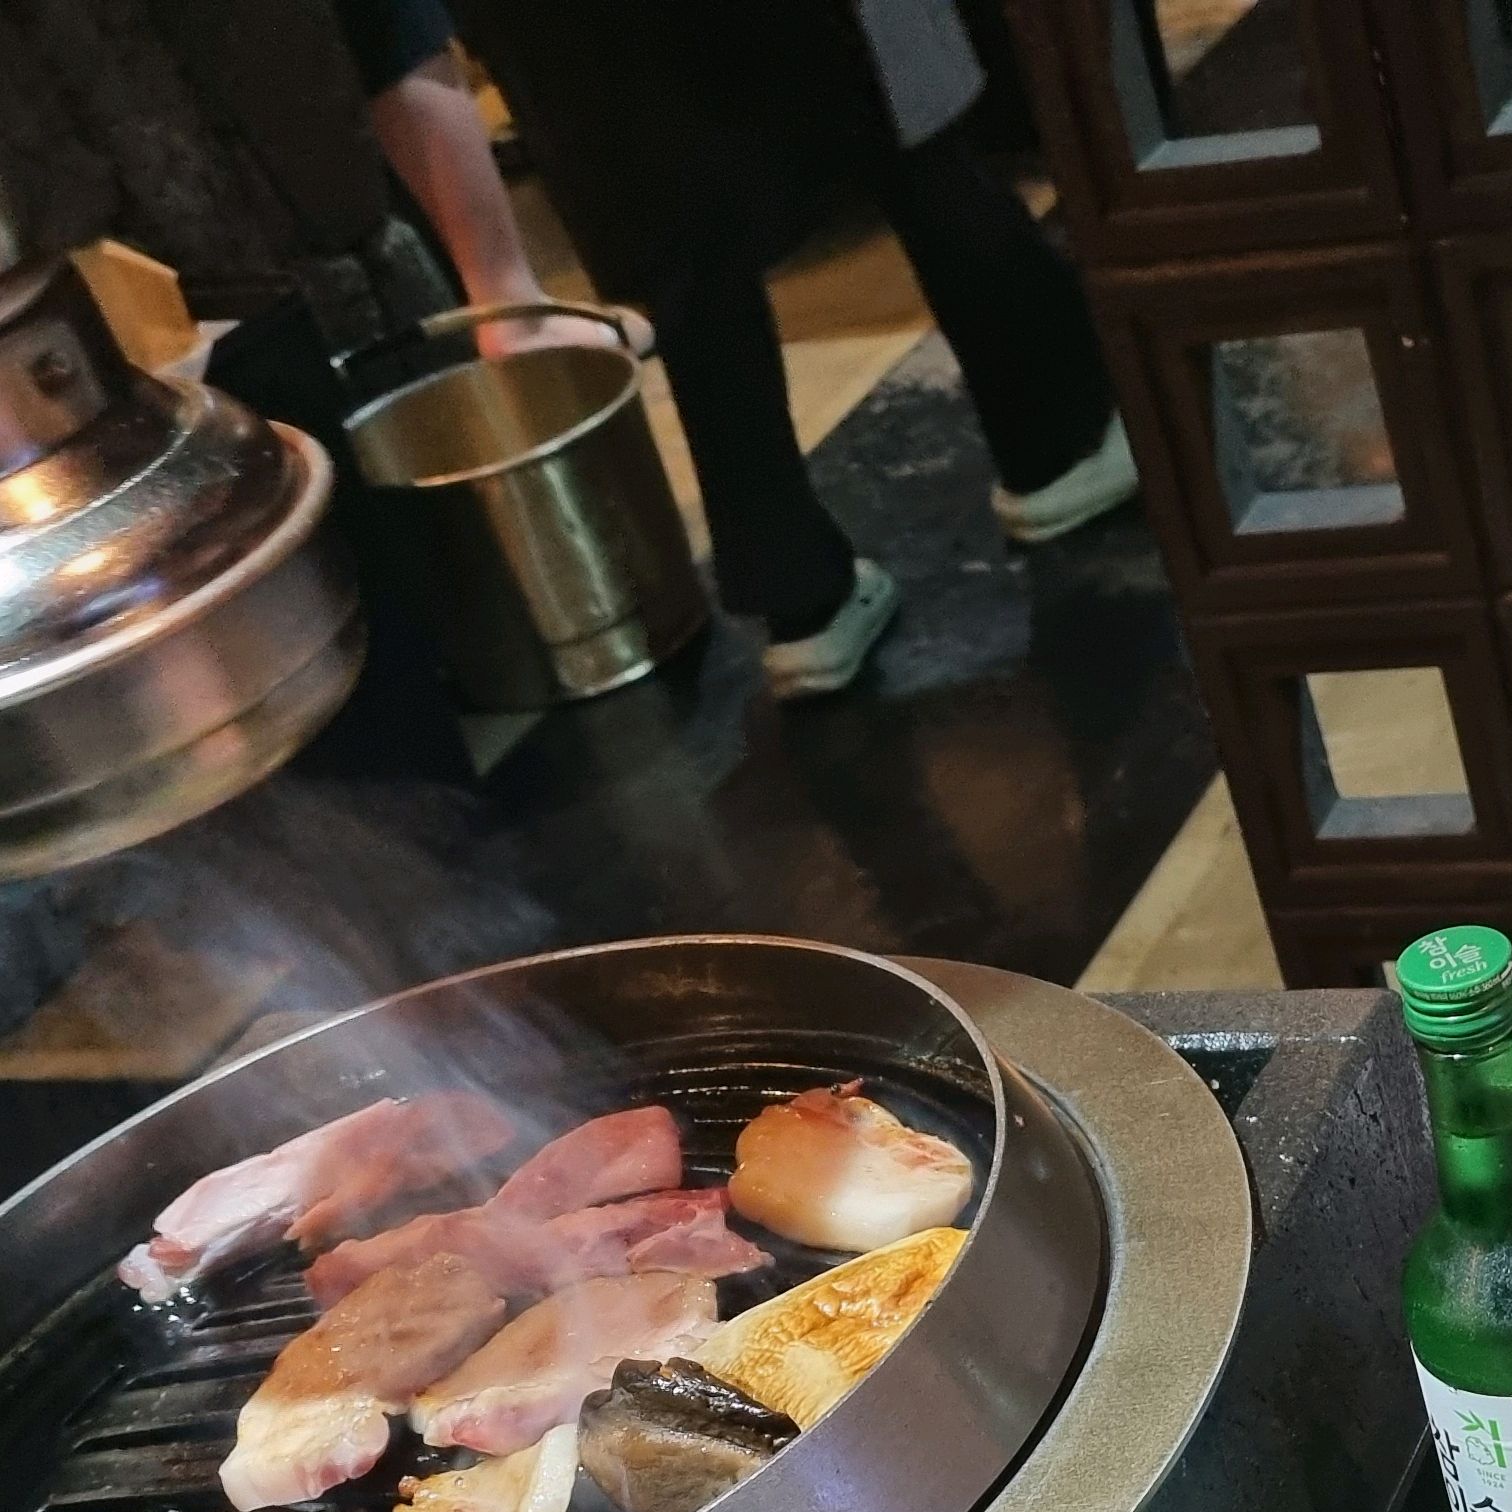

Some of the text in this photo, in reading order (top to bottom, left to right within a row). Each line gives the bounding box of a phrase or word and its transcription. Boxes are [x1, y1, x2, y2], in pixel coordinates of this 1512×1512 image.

[1440, 960, 1488, 984] fresh
[1476, 1467, 1507, 1482] SINCE
[1481, 1477, 1505, 1490] 1924
